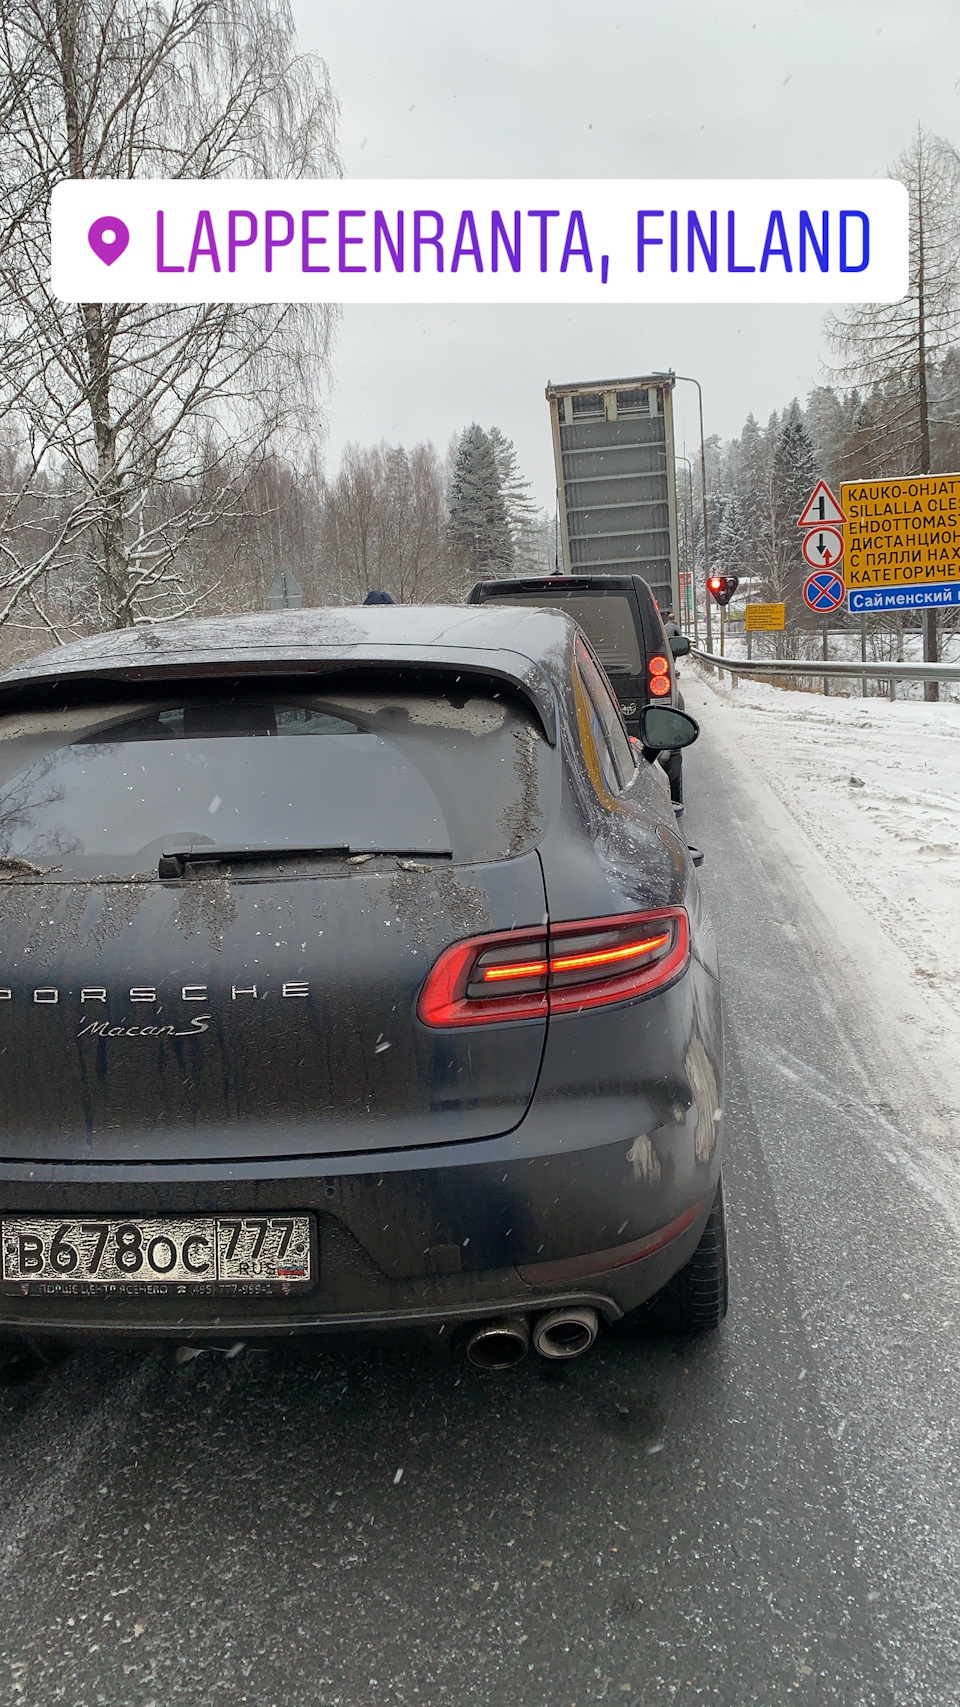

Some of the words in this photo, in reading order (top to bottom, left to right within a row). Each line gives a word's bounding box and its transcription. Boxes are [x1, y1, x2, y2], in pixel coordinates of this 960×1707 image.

[849, 500, 923, 518] SILLALLA
[928, 498, 960, 511] OLE
[849, 514, 960, 534] EHDOTTOMAST
[850, 555, 860, 567] С
[866, 550, 921, 566] ПЯЛЛИ
[850, 564, 960, 583] КАТЕГОРИЧЕ
[853, 588, 952, 608] Сайменский
[77, 1018, 175, 1037] Macan
[218, 1220, 295, 1260] 777
